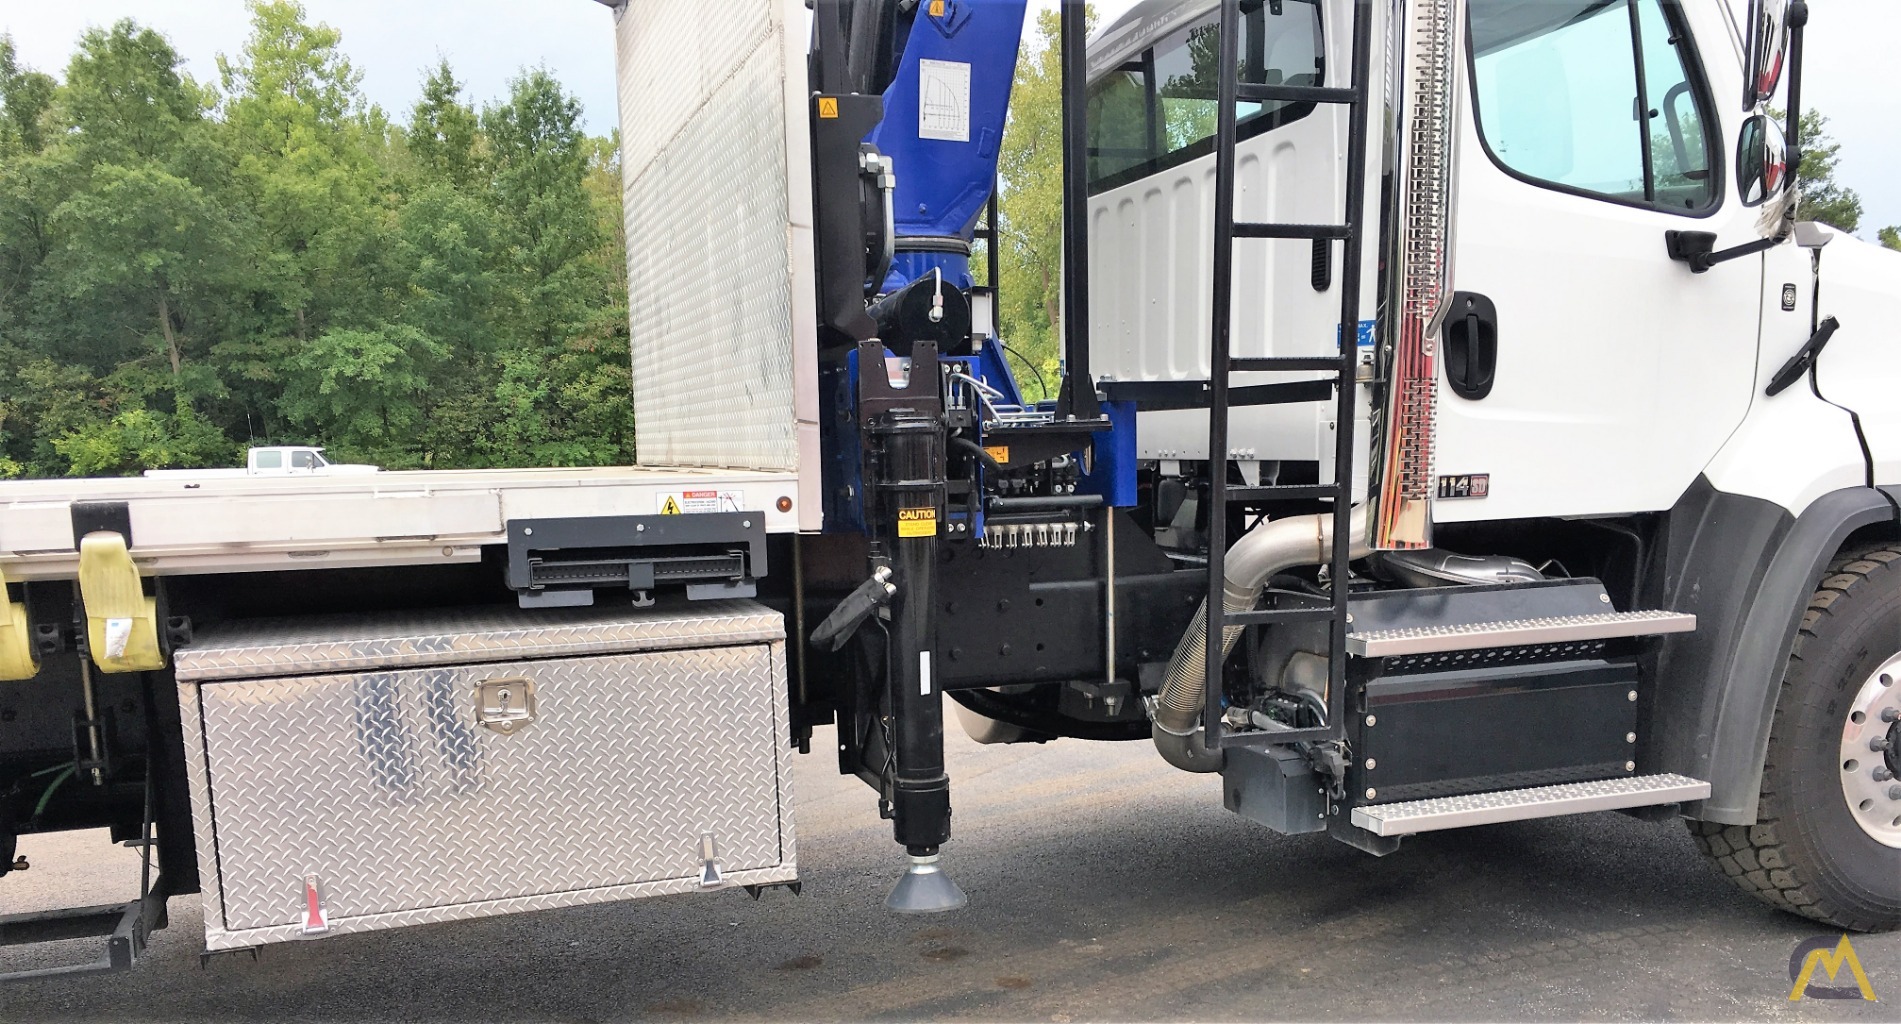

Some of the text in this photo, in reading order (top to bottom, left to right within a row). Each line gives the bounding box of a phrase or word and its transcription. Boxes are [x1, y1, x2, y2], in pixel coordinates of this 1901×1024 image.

[1440, 476, 1487, 497] 114 SD
[898, 509, 936, 520] CAUTION
